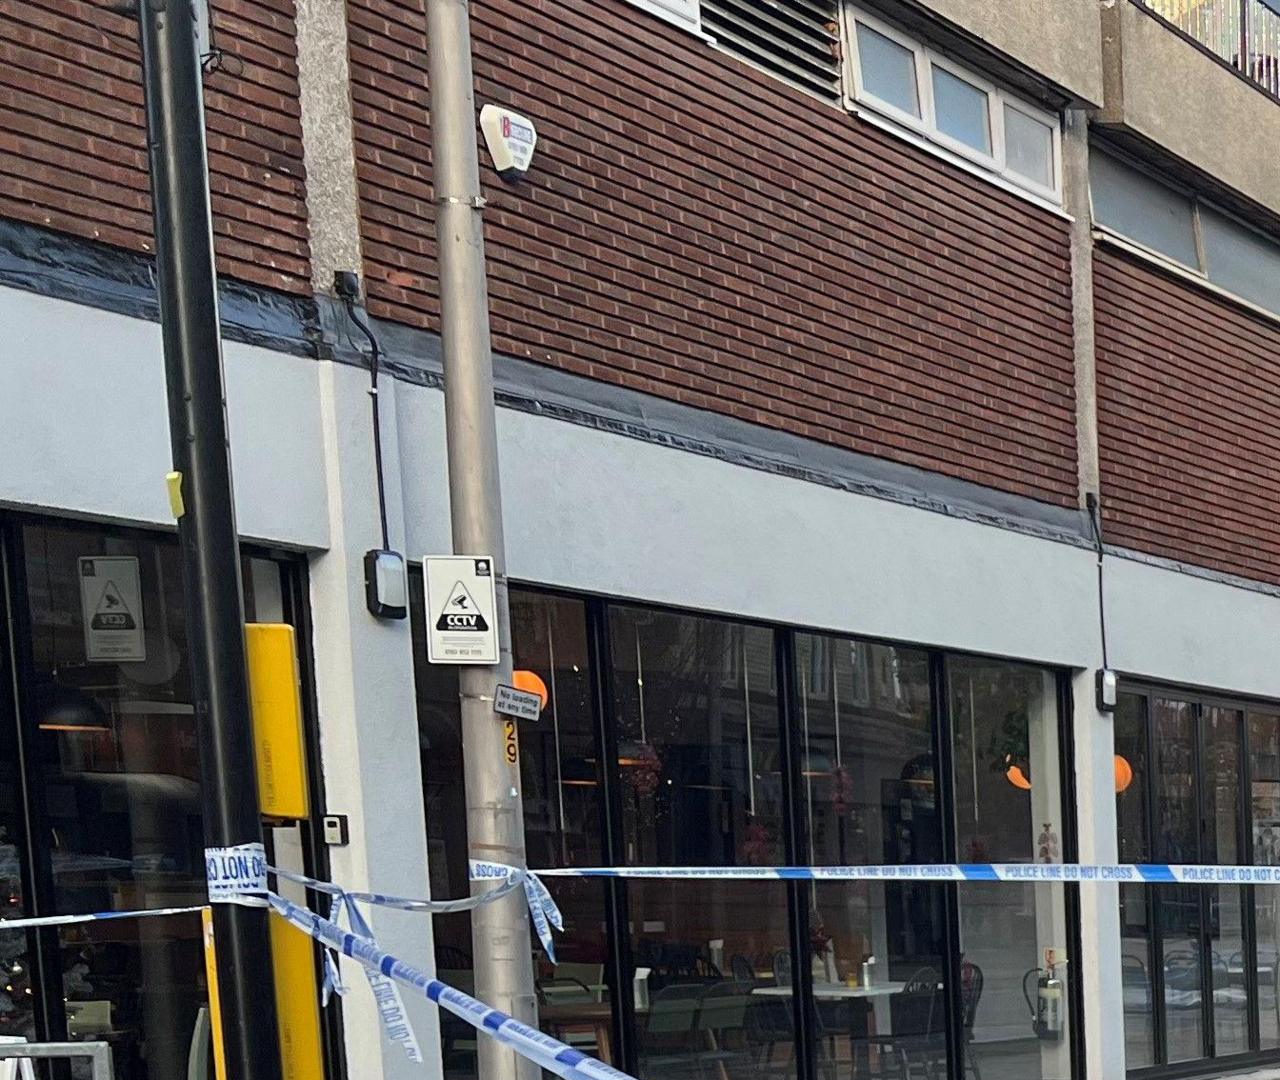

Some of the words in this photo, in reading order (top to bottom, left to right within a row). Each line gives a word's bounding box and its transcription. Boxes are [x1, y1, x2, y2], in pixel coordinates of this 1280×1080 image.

[446, 614, 478, 626] CCTV
[499, 689, 511, 700] No
[511, 692, 539, 709] loading
[497, 700, 505, 708] at
[506, 702, 519, 714] any
[520, 704, 538, 716] time
[506, 721, 518, 764] 29
[222, 854, 249, 880] NOT
[1004, 866, 1038, 878] POLICE
[1040, 866, 1062, 878] LINE
[1064, 866, 1078, 879] DO
[1080, 866, 1099, 879] NOT
[1101, 866, 1134, 879] CROSS
[1182, 868, 1214, 881] POLICE
[1216, 869, 1234, 881] LINE
[1238, 869, 1251, 882] DO
[1254, 869, 1272, 882] NOT
